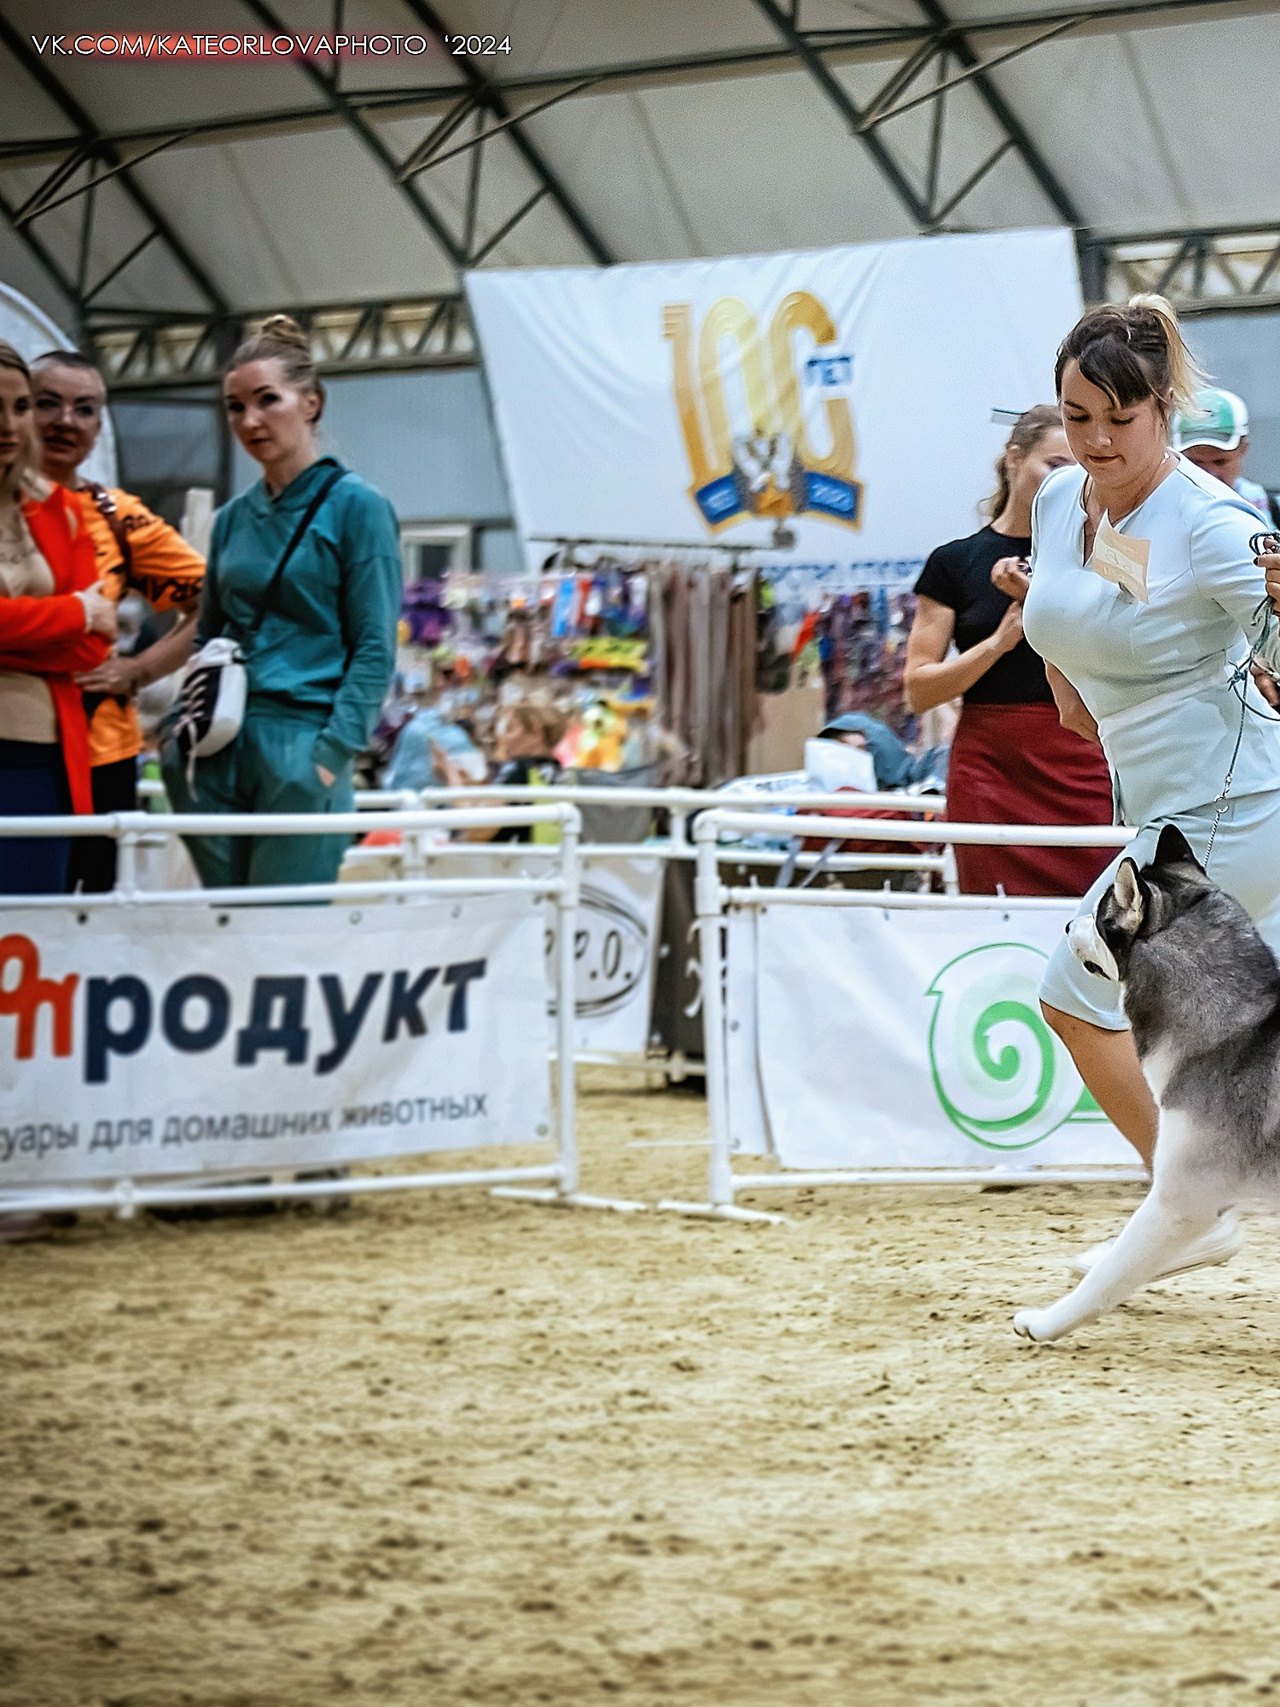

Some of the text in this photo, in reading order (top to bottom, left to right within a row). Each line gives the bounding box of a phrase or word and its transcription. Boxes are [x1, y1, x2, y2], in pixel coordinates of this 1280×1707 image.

[88, 1117, 154, 1154] для
[161, 1108, 333, 1149] домашних
[338, 1093, 488, 1131] животных
